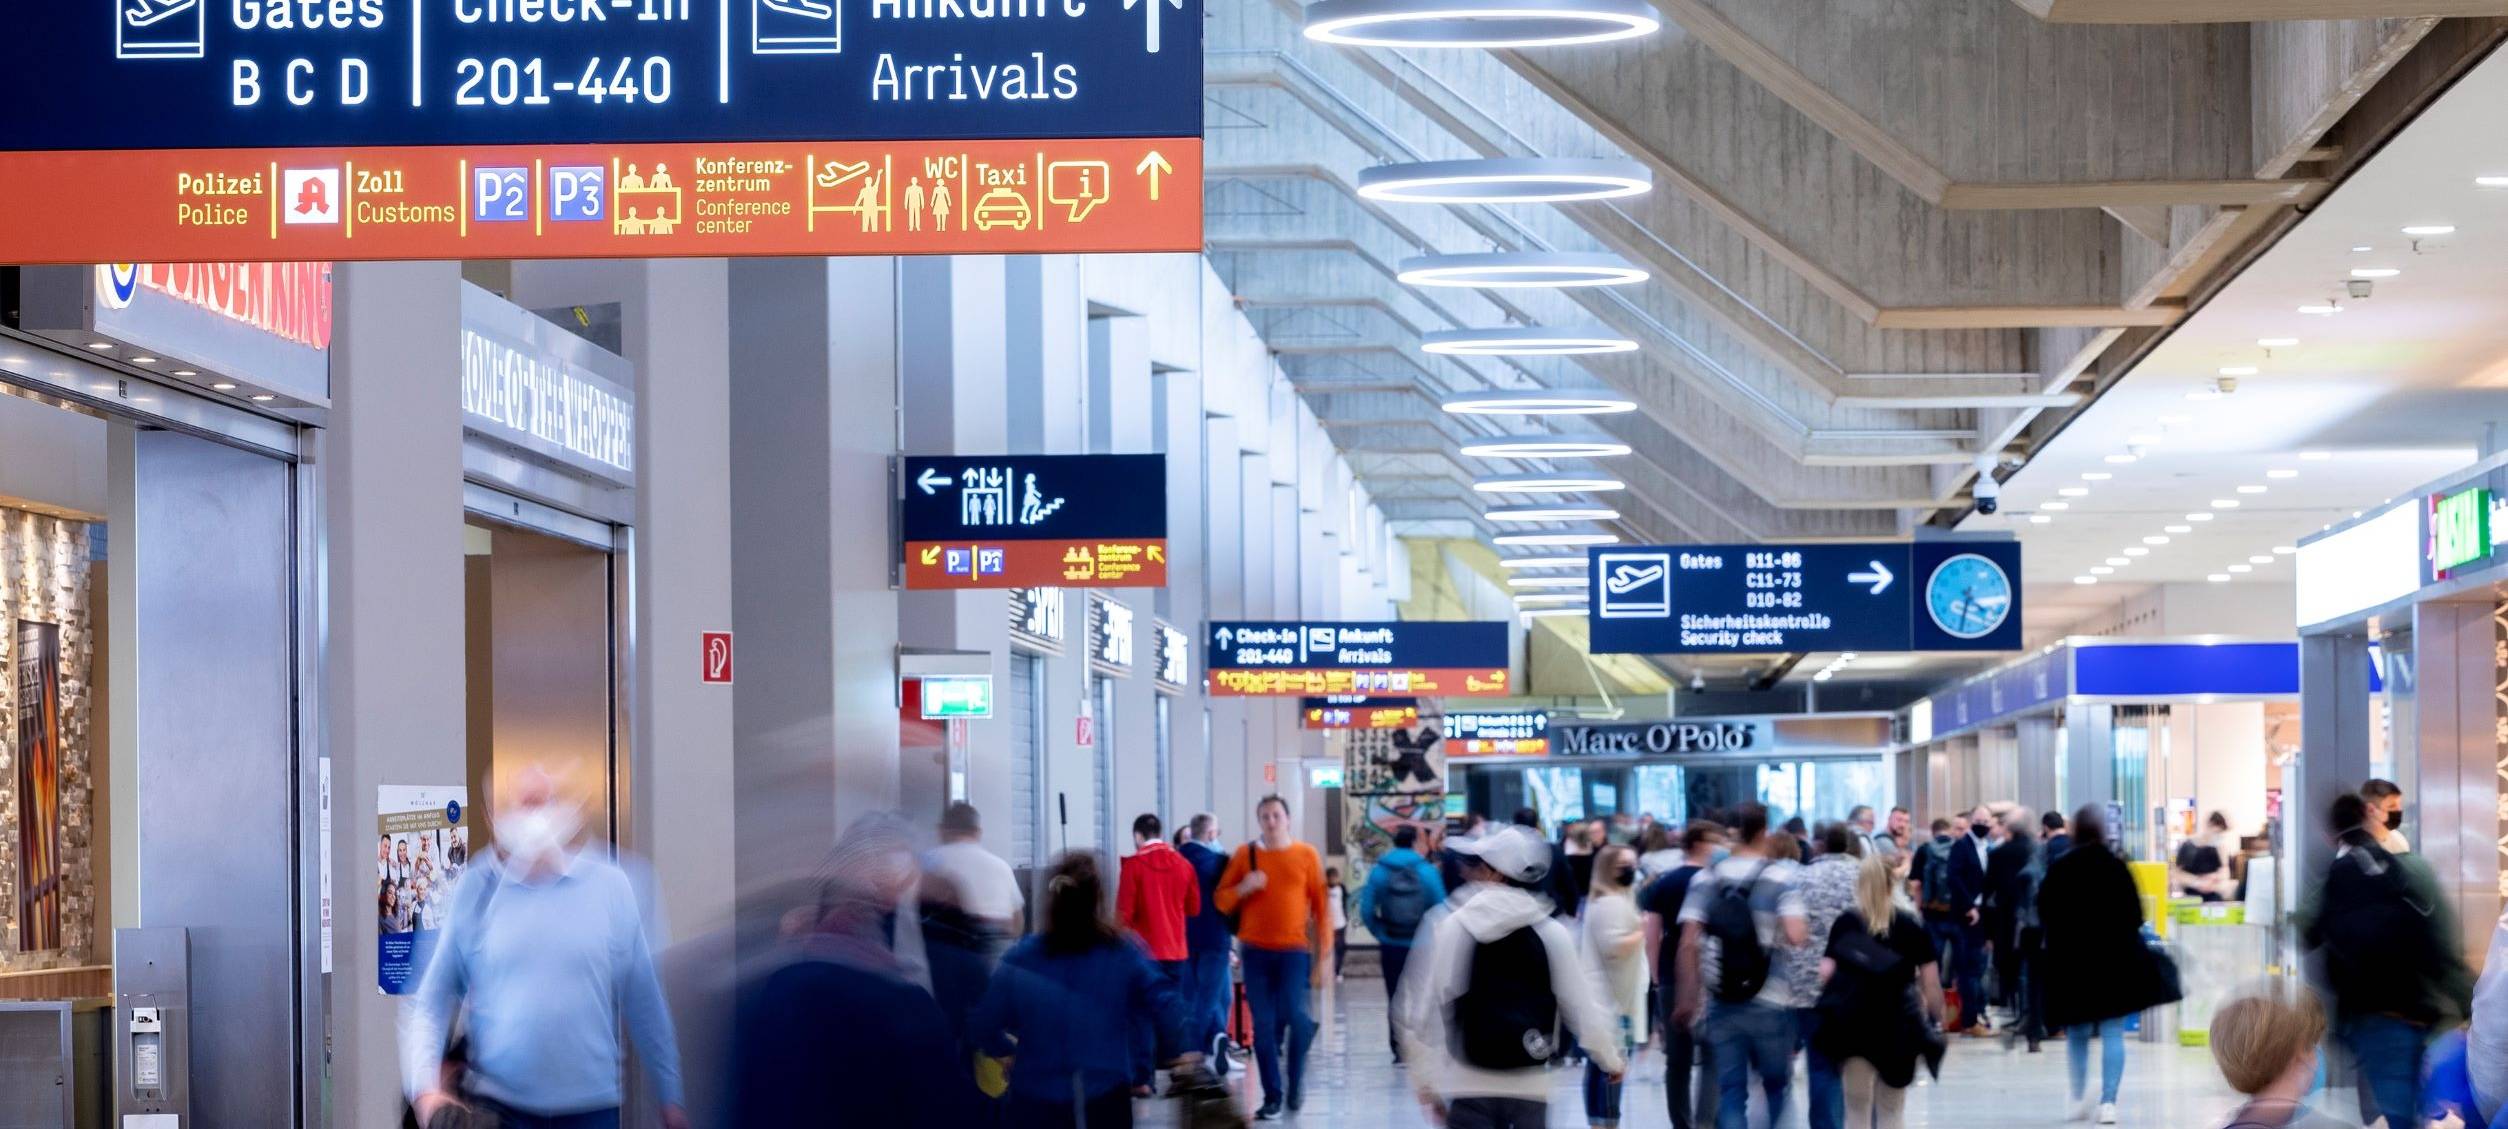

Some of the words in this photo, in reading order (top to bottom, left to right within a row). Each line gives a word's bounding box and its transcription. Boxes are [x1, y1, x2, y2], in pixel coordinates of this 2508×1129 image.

[232, 0, 385, 29] Gates
[233, 59, 261, 106] B
[286, 58, 314, 106] C
[341, 58, 369, 105] D
[455, 56, 671, 105] 201-440
[872, 52, 1079, 101] Arrivals
[696, 157, 793, 174] Konferenz-
[925, 156, 958, 180] WC
[976, 162, 1027, 186] Taxi
[178, 172, 263, 196] Polizei
[357, 170, 404, 193] Zoll
[696, 176, 771, 192] zentrum
[178, 203, 249, 226] Police
[357, 201, 456, 224] Customs
[696, 198, 791, 217] Conference
[696, 217, 753, 234] center
[1680, 552, 1723, 570] Gates
[1746, 572, 1802, 588] C11-73
[1680, 612, 1832, 630] Sicherheitskontrolle
[1236, 628, 1298, 644] Check-in
[1680, 630, 1740, 648] Security
[1742, 629, 1784, 646] check
[1338, 648, 1393, 664] Arrivals
[1562, 727, 1639, 755] Marc
[1645, 723, 1745, 753] O'Polo
